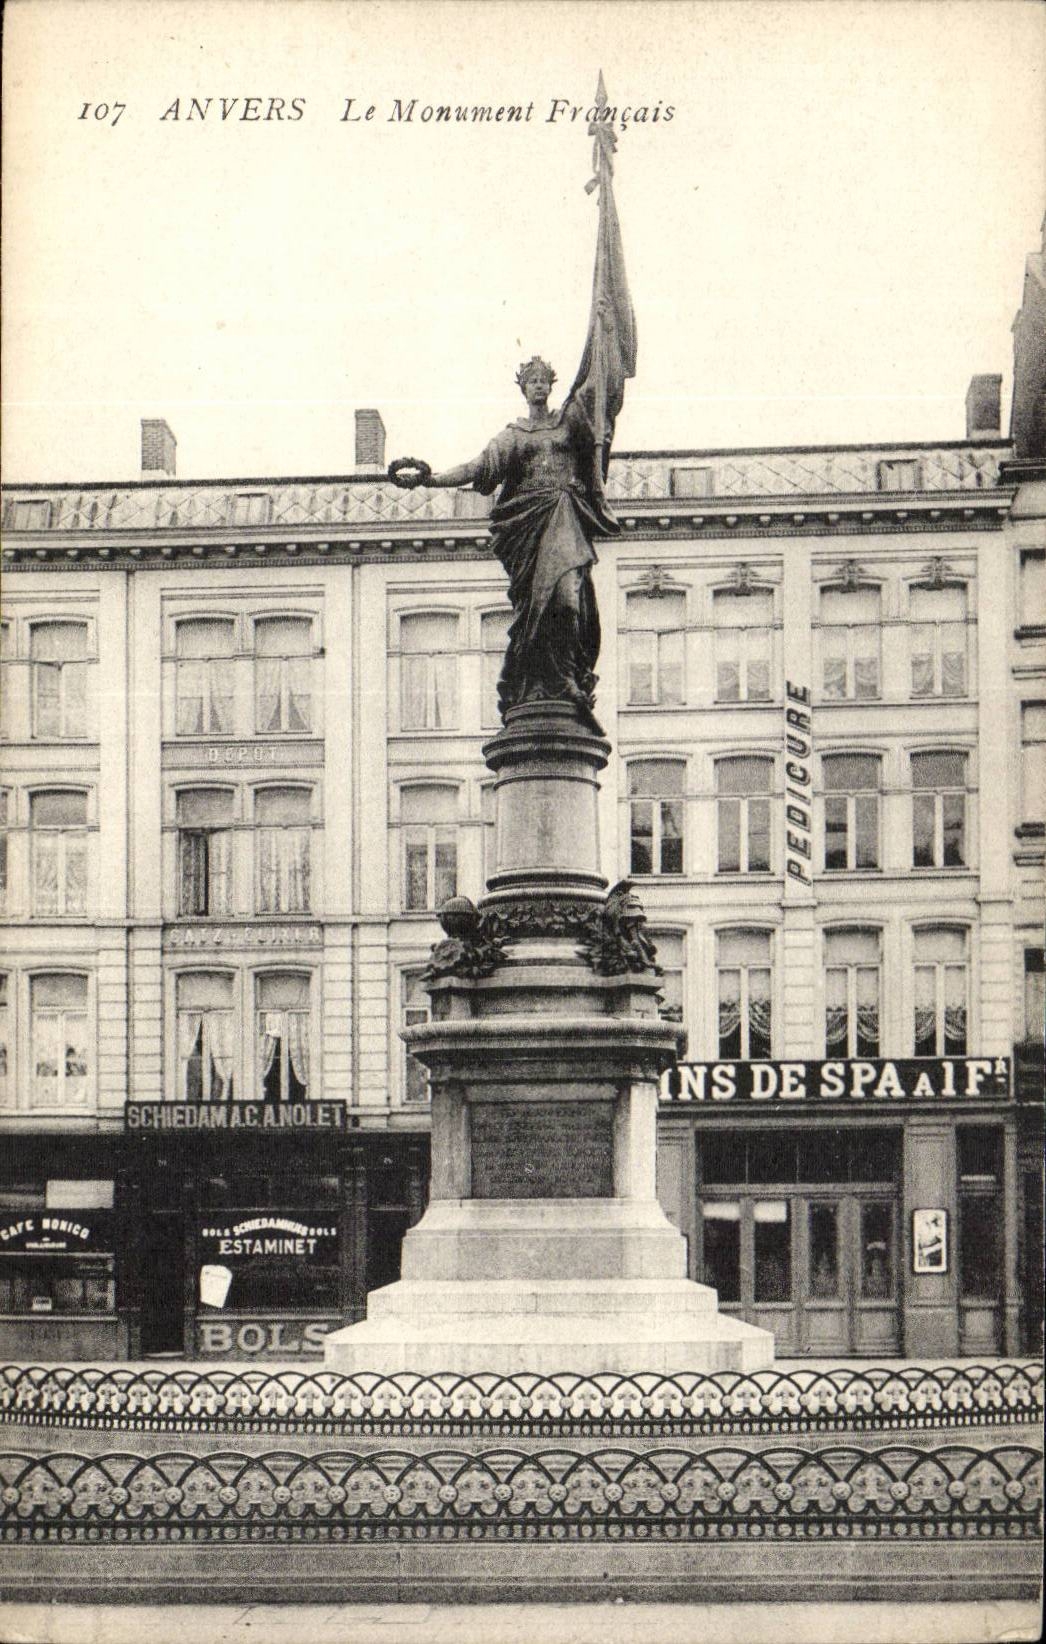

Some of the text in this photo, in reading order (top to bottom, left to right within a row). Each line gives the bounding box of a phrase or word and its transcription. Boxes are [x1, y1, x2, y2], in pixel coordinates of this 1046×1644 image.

[786, 680, 812, 887] PEDICURE
[750, 1063, 806, 1099] DE
[820, 1061, 905, 1098] SPA
[913, 1072, 935, 1097] A
[128, 1103, 228, 1129] SCHIEDAM
[218, 1239, 318, 1255] ESTAMINET
[200, 1323, 328, 1352] BOLS
